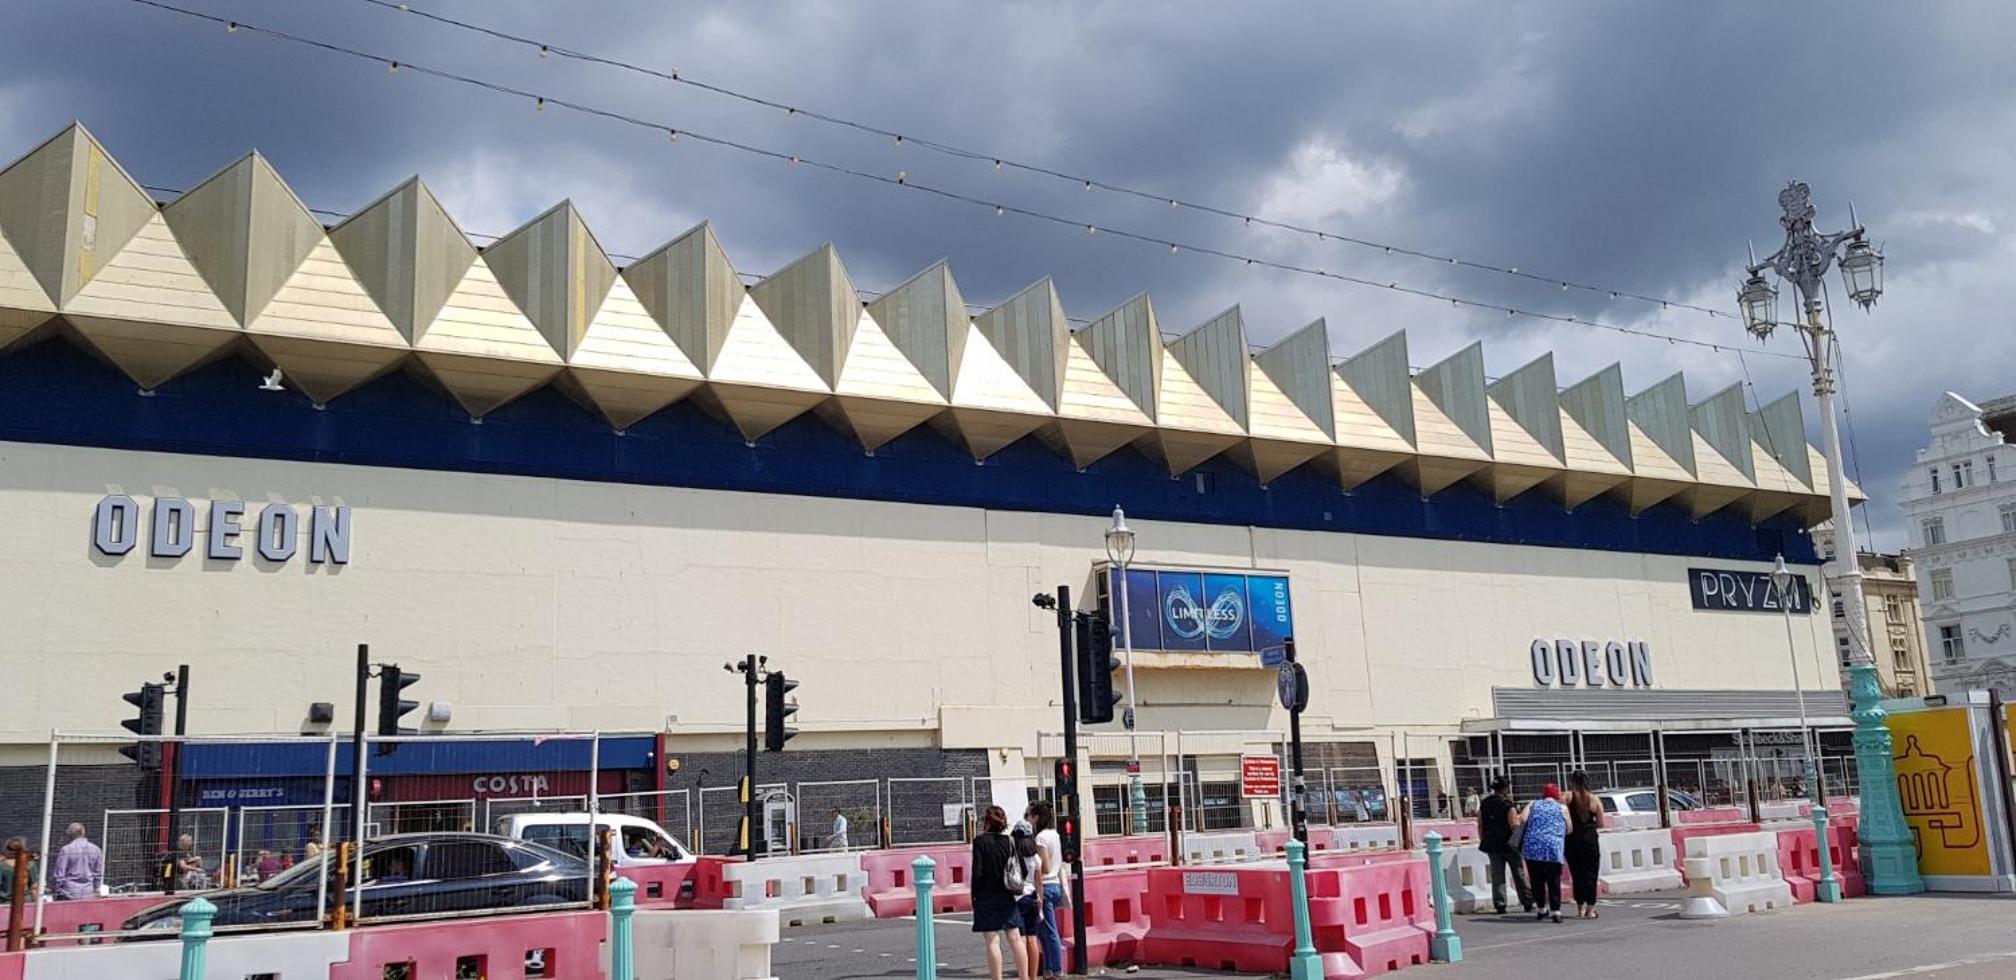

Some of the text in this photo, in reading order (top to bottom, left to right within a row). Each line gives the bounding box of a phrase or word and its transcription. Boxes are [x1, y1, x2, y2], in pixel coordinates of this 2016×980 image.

[94, 494, 351, 565] ODEON
[1274, 582, 1288, 623] ODEON
[1701, 572, 1801, 610] PRYZM
[1172, 606, 1237, 621] LIMITLESS
[1530, 639, 1654, 687] ODEON
[203, 790, 226, 799] BEN
[227, 789, 237, 799] &
[473, 775, 549, 794] COSTA
